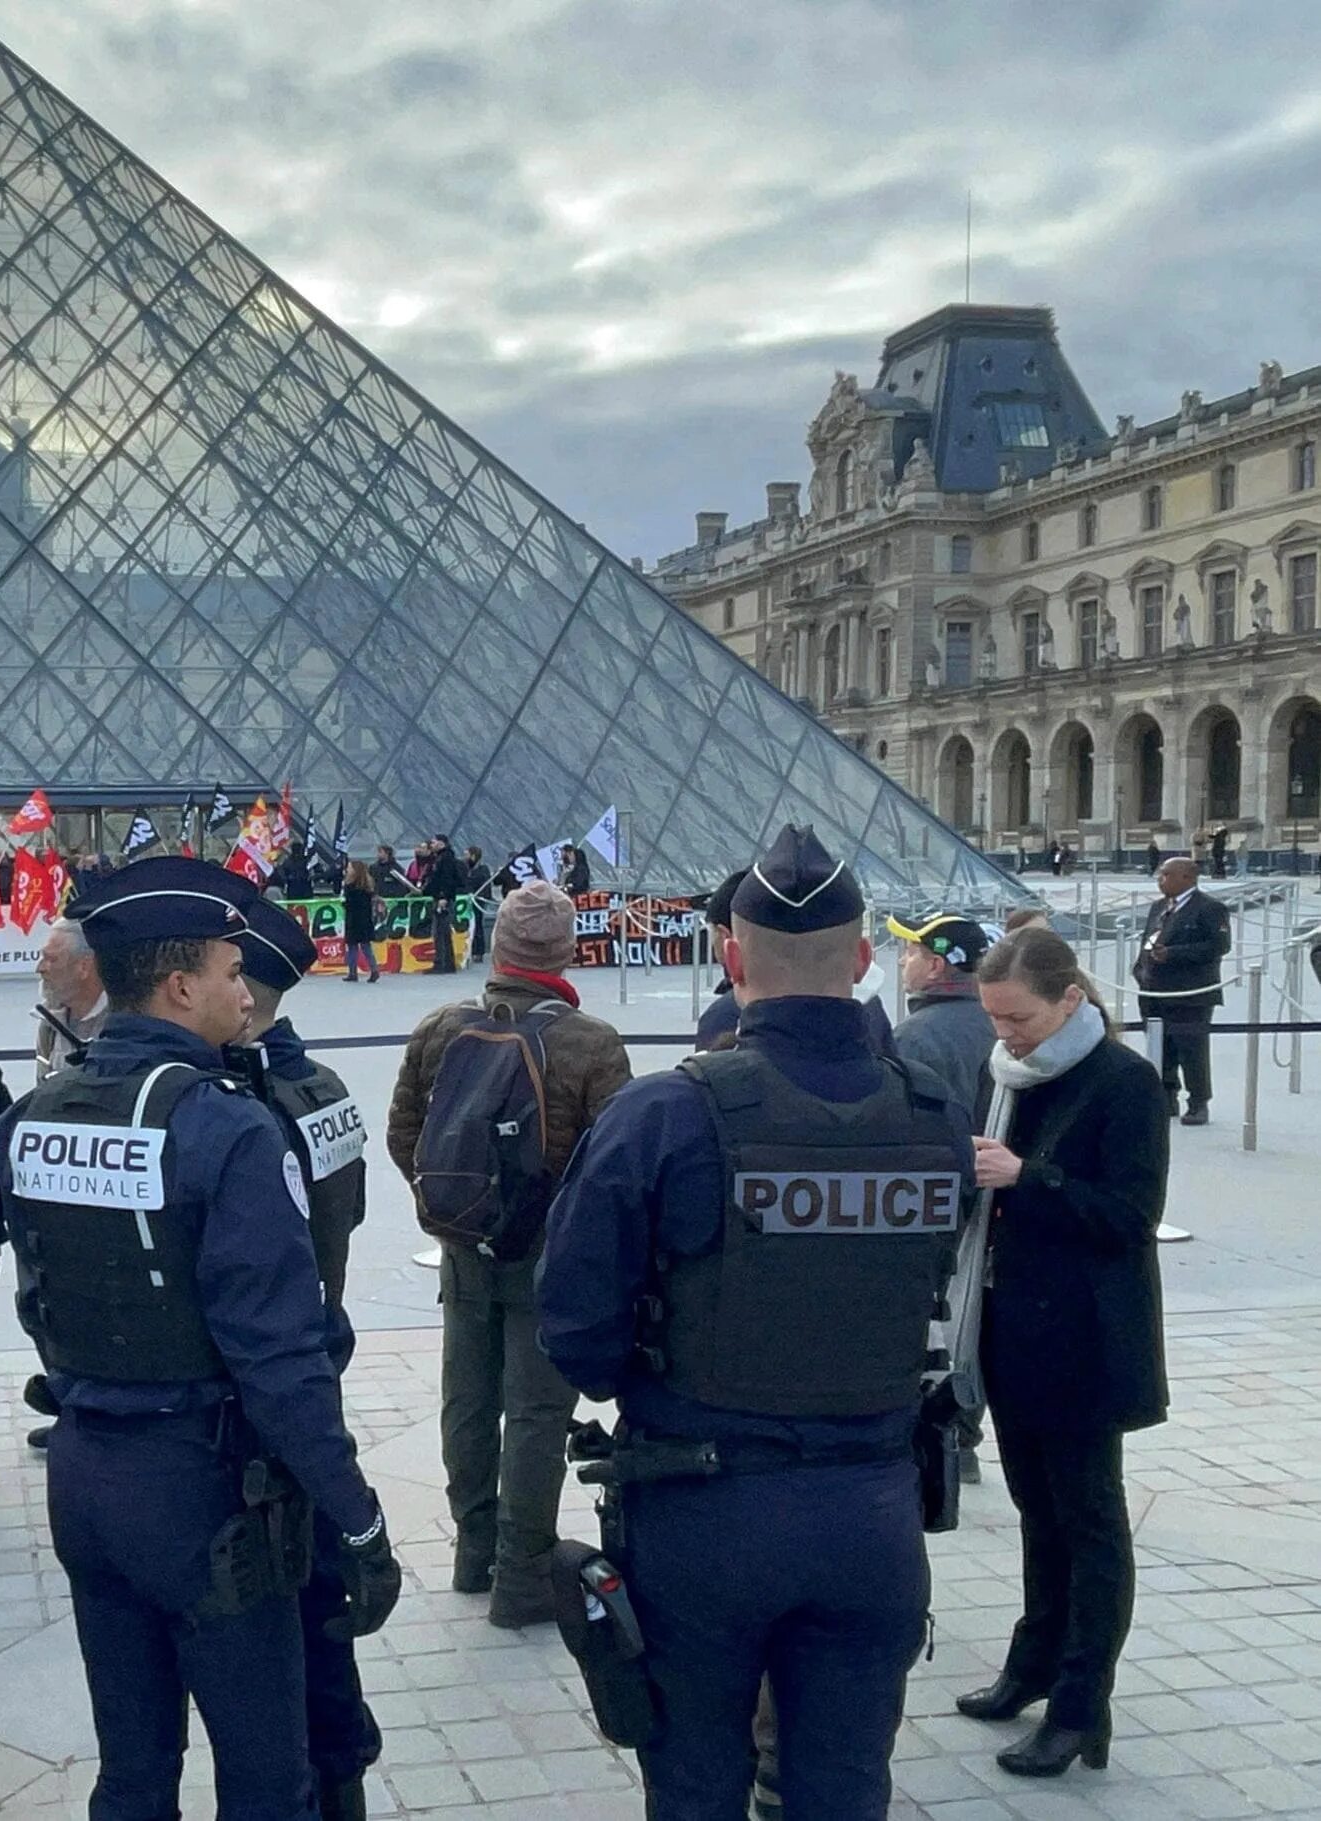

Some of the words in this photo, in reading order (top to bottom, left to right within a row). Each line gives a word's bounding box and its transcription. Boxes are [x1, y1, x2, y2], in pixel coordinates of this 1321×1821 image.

[13, 949, 41, 962] PLU
[614, 940, 662, 966] NON
[307, 1103, 362, 1149] POLICE
[16, 1131, 151, 1173] POLICE
[16, 1170, 152, 1200] NATIONALE
[742, 1177, 955, 1228] POLICE
